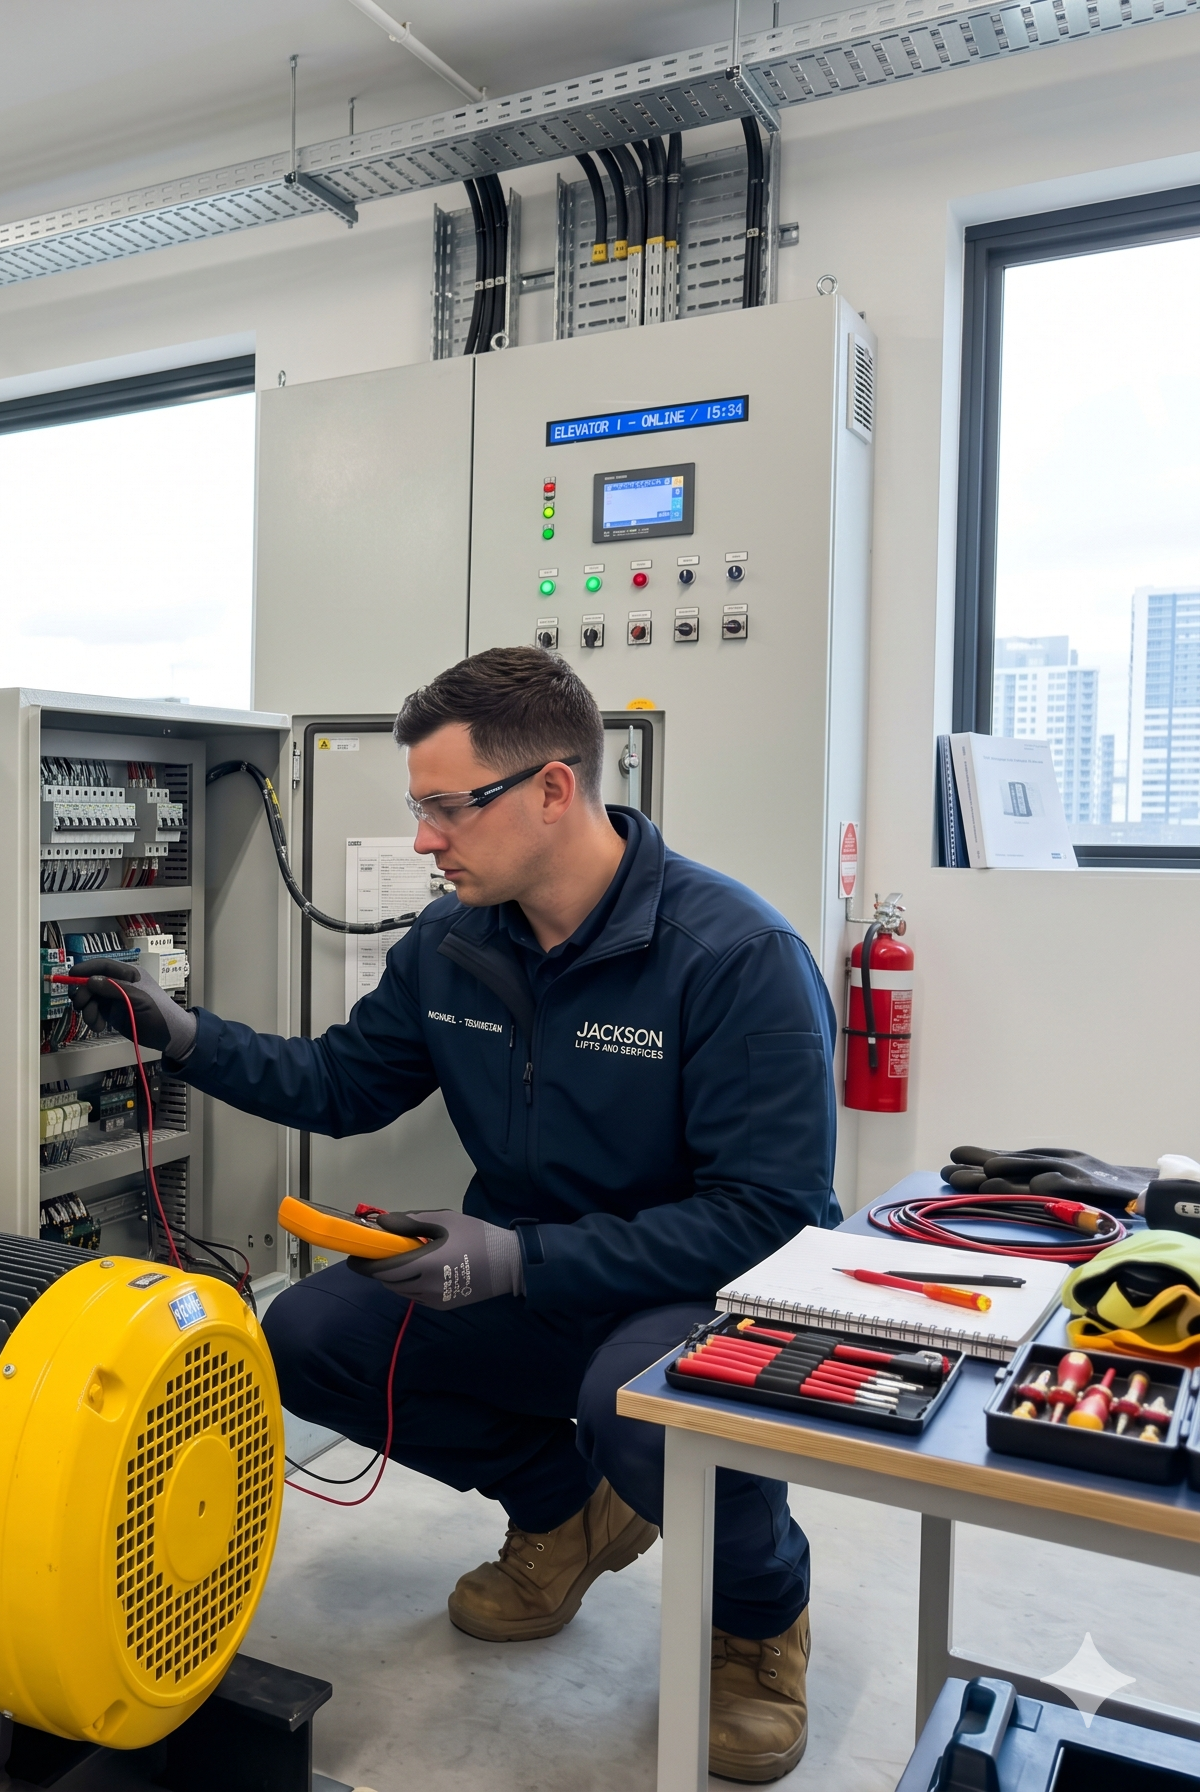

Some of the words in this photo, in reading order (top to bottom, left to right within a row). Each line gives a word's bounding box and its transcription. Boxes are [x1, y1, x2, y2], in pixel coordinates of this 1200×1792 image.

[554, 420, 609, 439] ELEVATOR
[706, 403, 743, 420] 15:34
[576, 1021, 663, 1048] JACKSON
